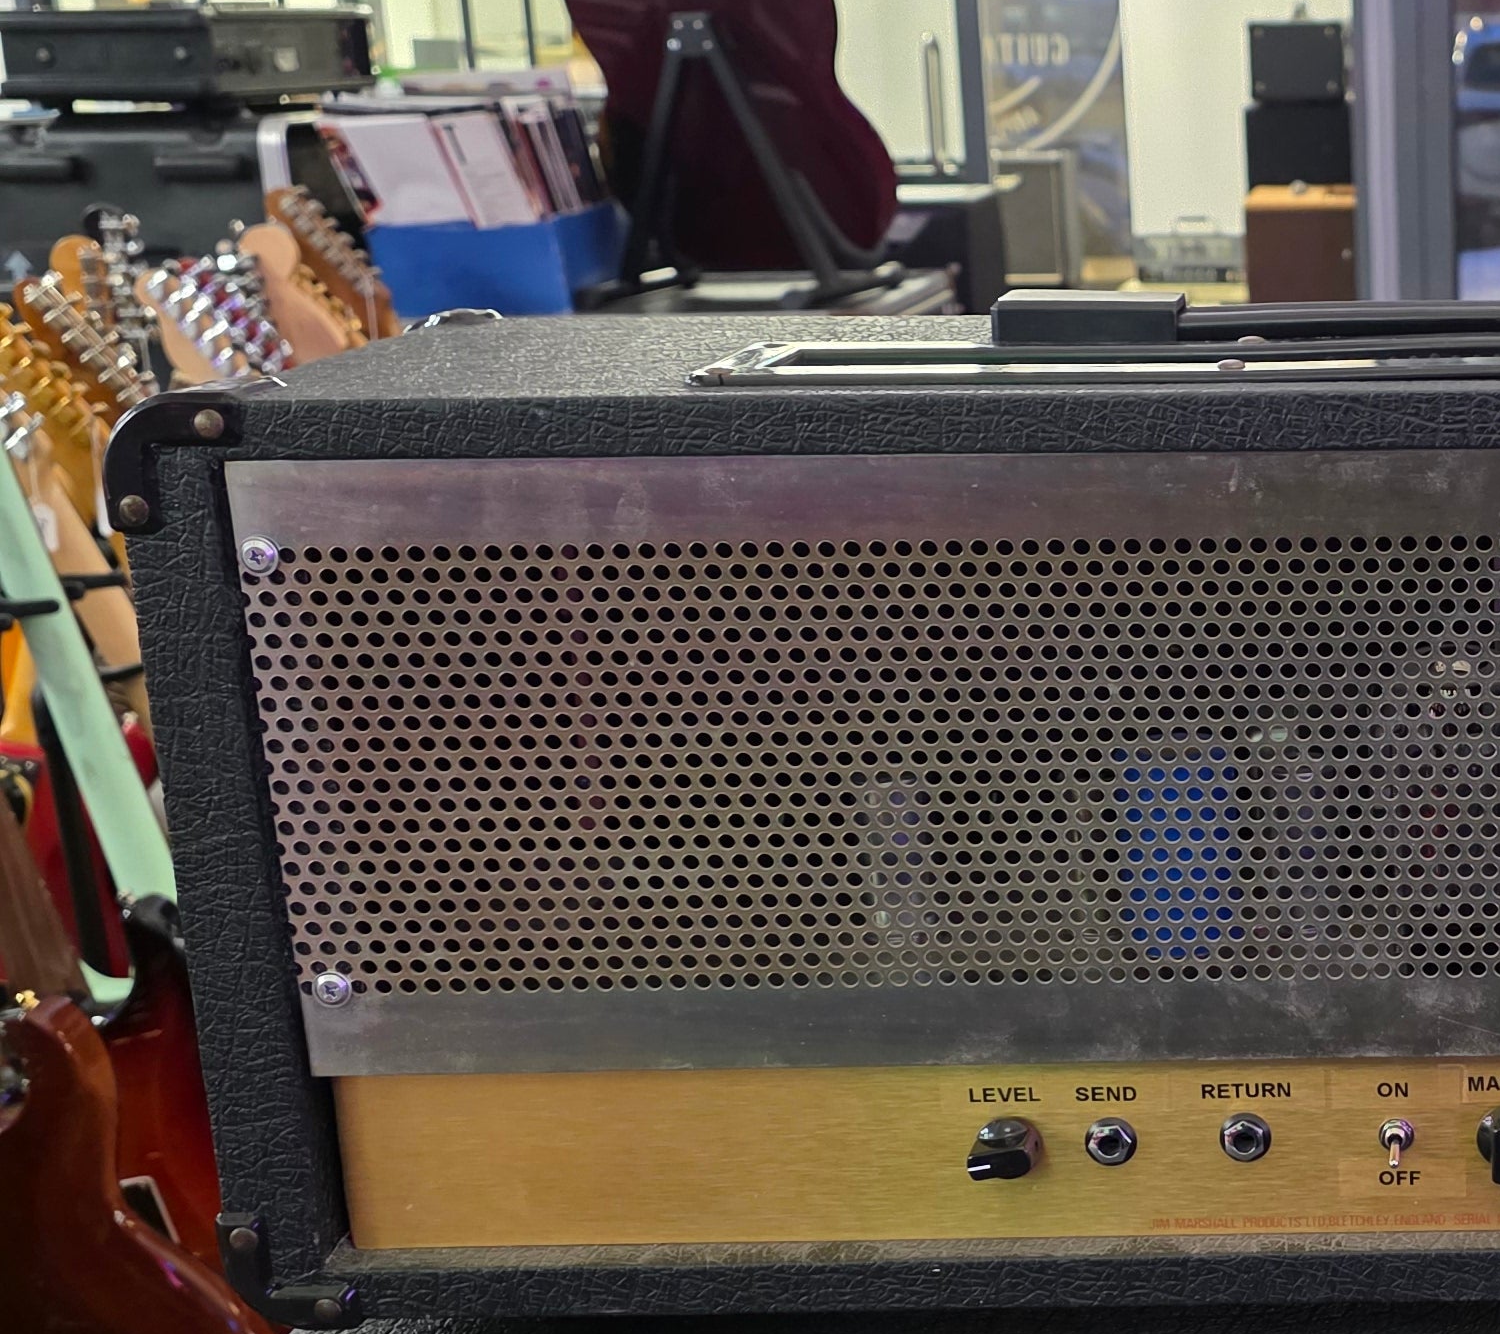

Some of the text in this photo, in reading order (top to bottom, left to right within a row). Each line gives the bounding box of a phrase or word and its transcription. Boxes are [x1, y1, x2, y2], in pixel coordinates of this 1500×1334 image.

[968, 1087, 1041, 1103] LEVEL
[1075, 1086, 1138, 1102] SEND
[1200, 1082, 1292, 1099] RETURN
[1376, 1082, 1409, 1098] ON
[1378, 1170, 1421, 1186] OFF
[1175, 1217, 1236, 1229] MARSHALL
[1243, 1216, 1301, 1228] PRODUCTS
[1454, 1214, 1491, 1225] SERIAL
